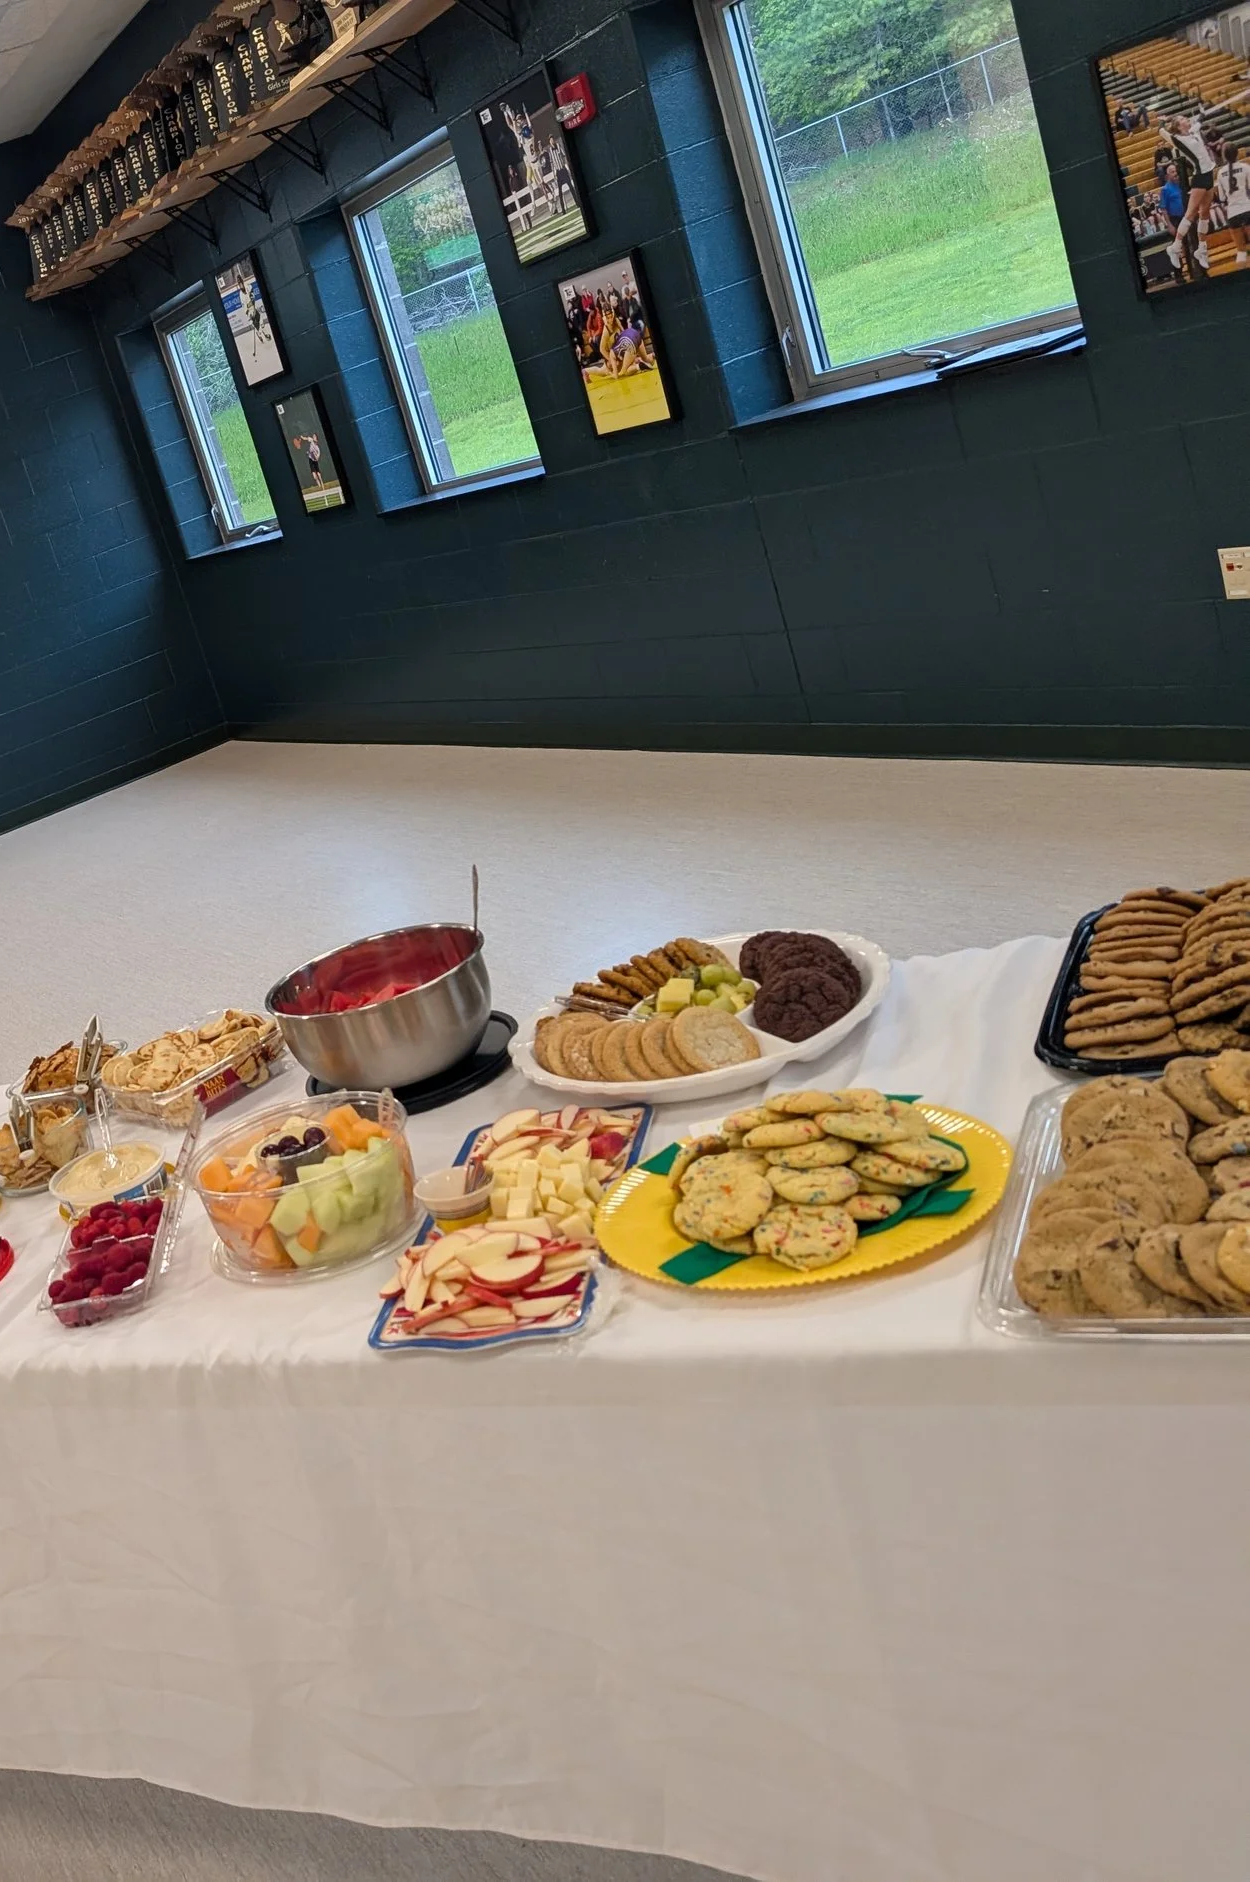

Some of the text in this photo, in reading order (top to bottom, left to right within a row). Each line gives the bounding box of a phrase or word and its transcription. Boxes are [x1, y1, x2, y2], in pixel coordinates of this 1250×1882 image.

[252, 27, 275, 83] CHAMPION
[196, 79, 219, 130] CHAMPION
[214, 62, 238, 115] CHAMPION
[164, 108, 185, 156] CHAMPION
[114, 157, 132, 202] CHAMPION
[127, 145, 148, 191] CHAMPION
[86, 182, 103, 225] CHAMPION
[100, 171, 118, 214] CHAMPION
[31, 234, 47, 273] CHAMPION
[203, 1073, 224, 1089] NAAN
[206, 1083, 227, 1098] BITES
